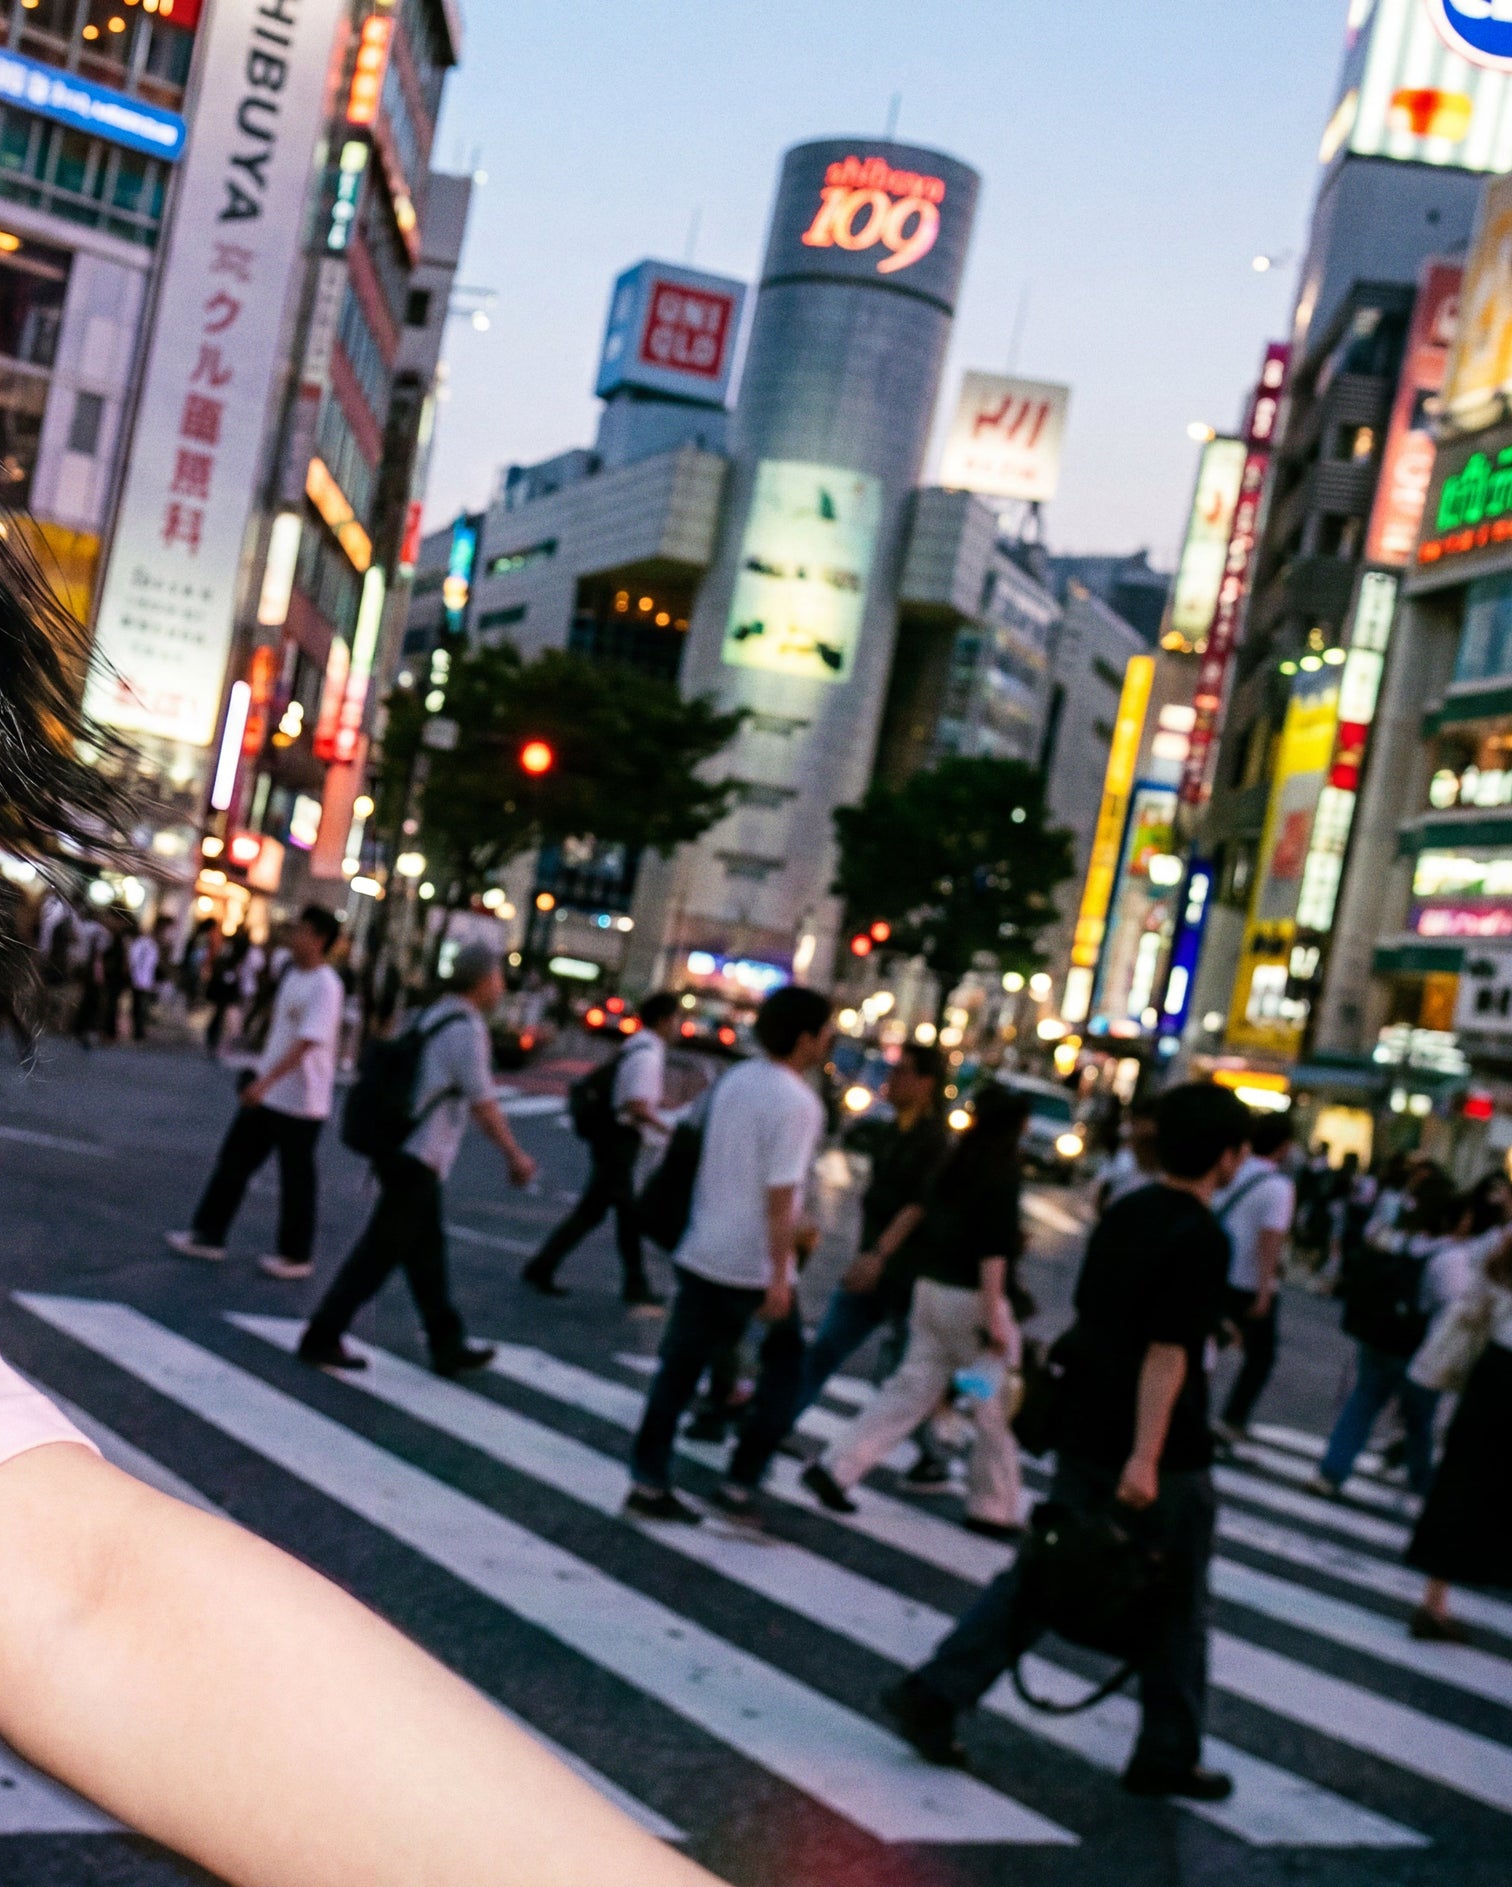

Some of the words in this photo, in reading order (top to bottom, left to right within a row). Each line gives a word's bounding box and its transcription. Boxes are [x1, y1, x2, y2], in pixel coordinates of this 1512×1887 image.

[218, 0, 295, 222] HIBUYA
[801, 185, 941, 274] 109
[656, 290, 721, 332] UNI
